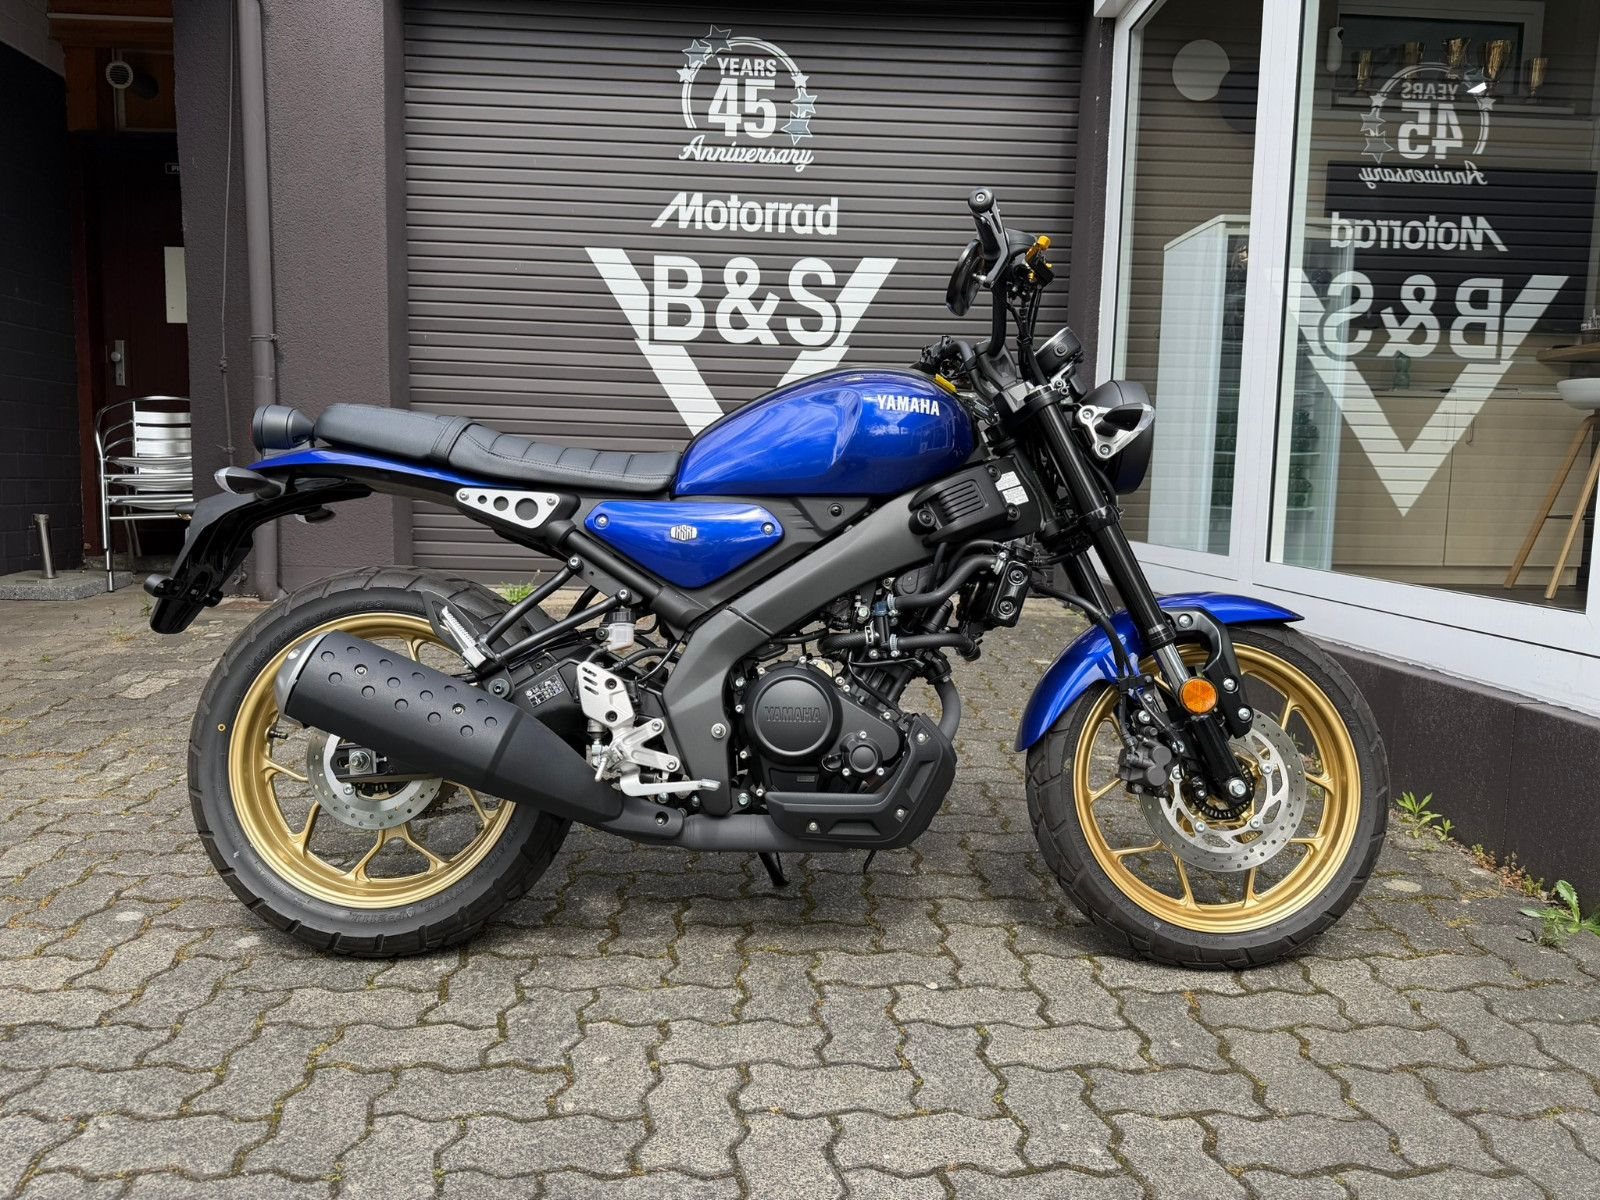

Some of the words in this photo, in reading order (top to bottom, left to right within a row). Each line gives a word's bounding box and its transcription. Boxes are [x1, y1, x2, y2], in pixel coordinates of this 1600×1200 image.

[717, 57, 777, 78] YEARS
[707, 78, 777, 139] 45
[678, 134, 815, 172] Anniversary
[651, 191, 839, 236] Motorrad
[653, 254, 837, 347] B&S
[877, 394, 940, 417] YAMAHA
[675, 524, 694, 541] XSR
[764, 706, 821, 723] YAMAHA
